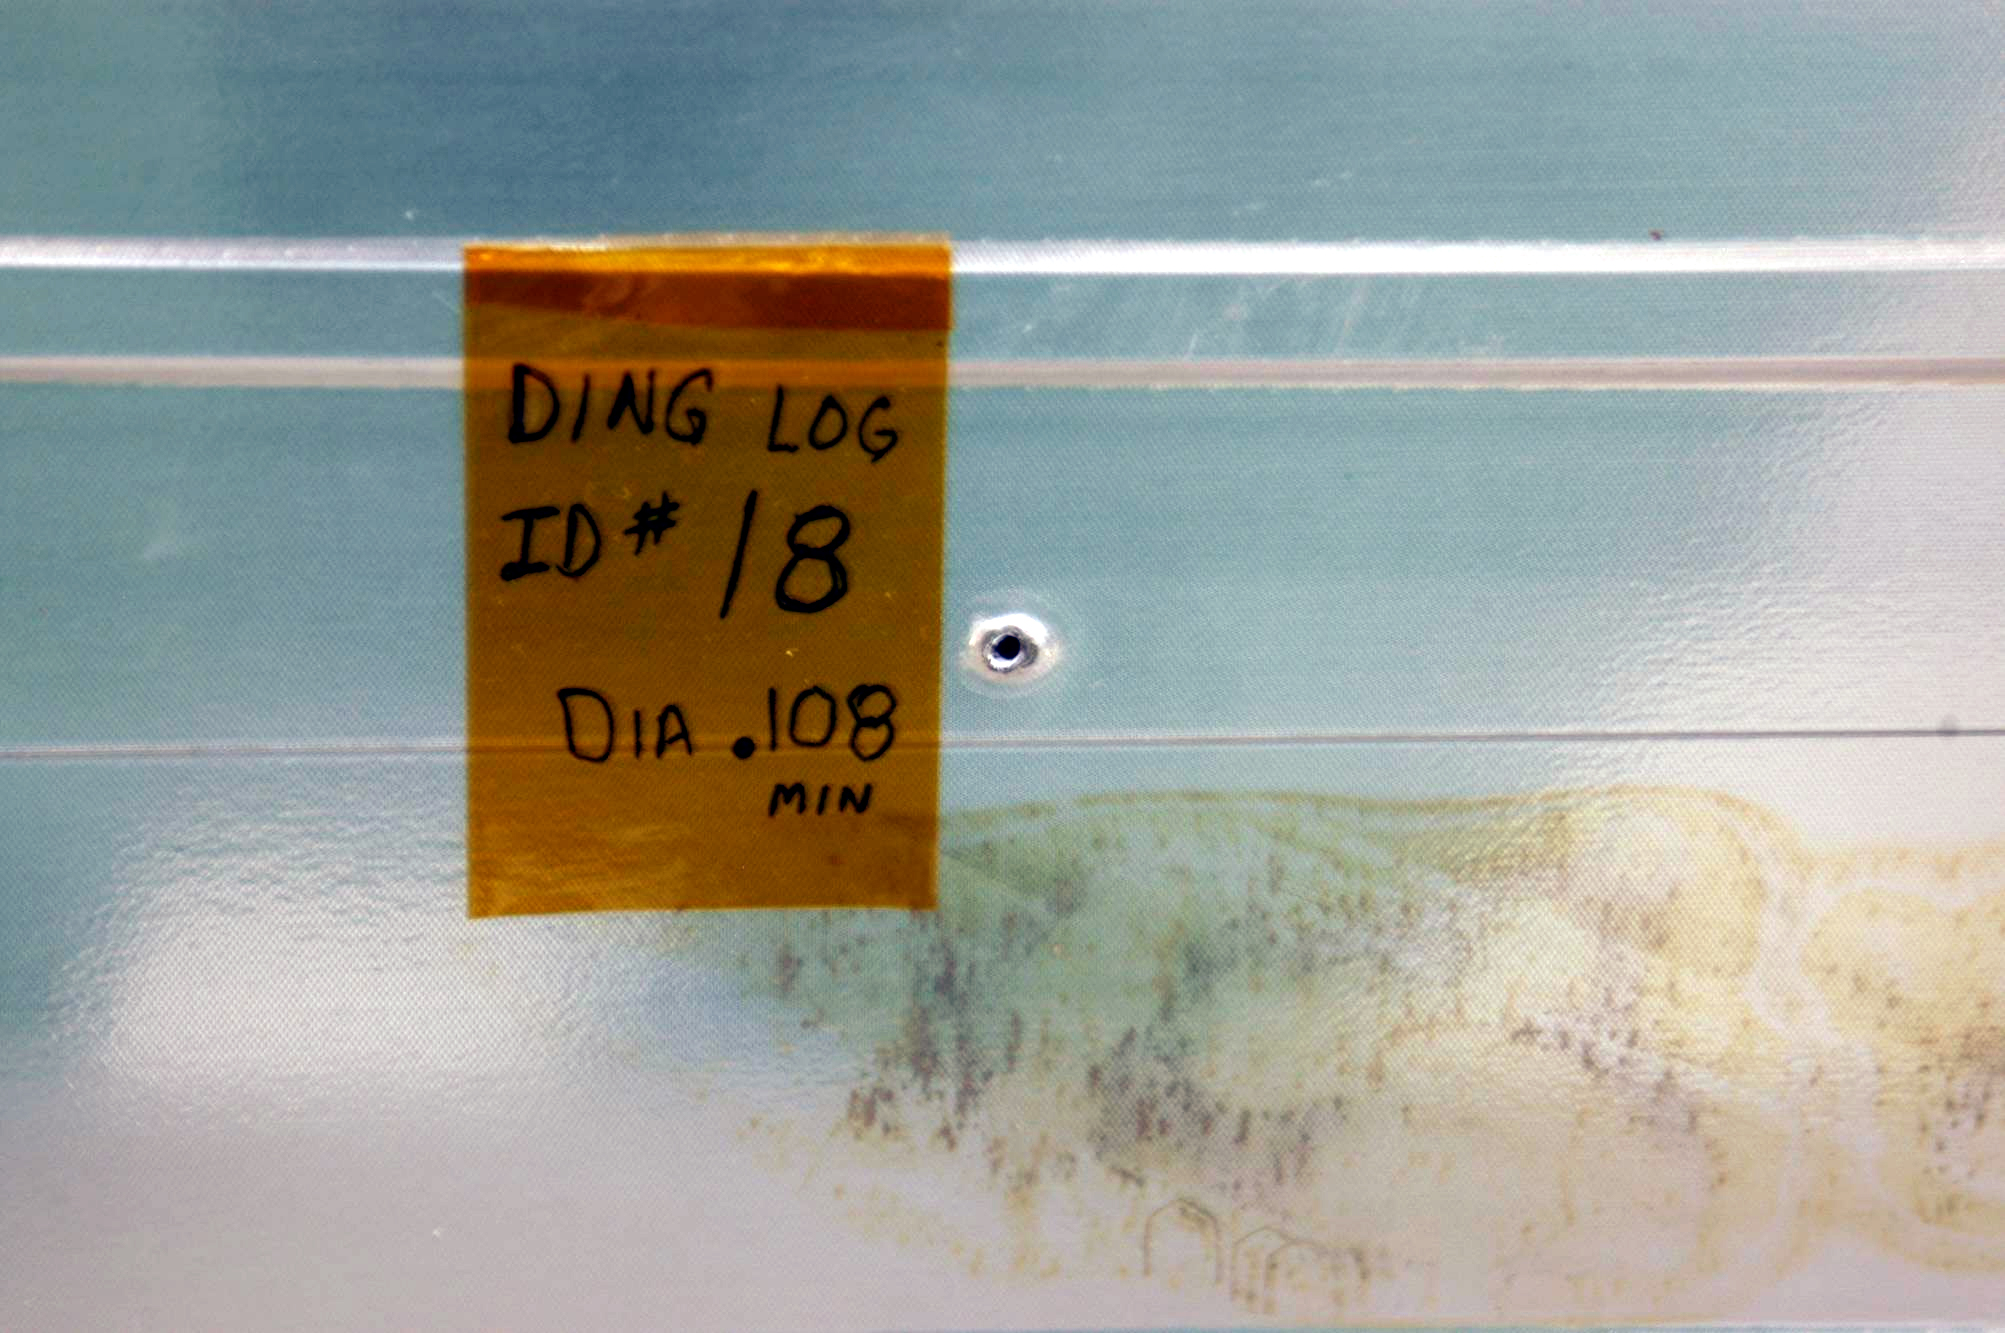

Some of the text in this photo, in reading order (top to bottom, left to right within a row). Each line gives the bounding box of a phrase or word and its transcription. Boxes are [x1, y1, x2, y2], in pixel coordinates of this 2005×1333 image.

[508, 363, 904, 462] DING LOG
[718, 489, 852, 616] 18
[557, 684, 898, 763] DIA .108
[768, 782, 875, 817] MIN
